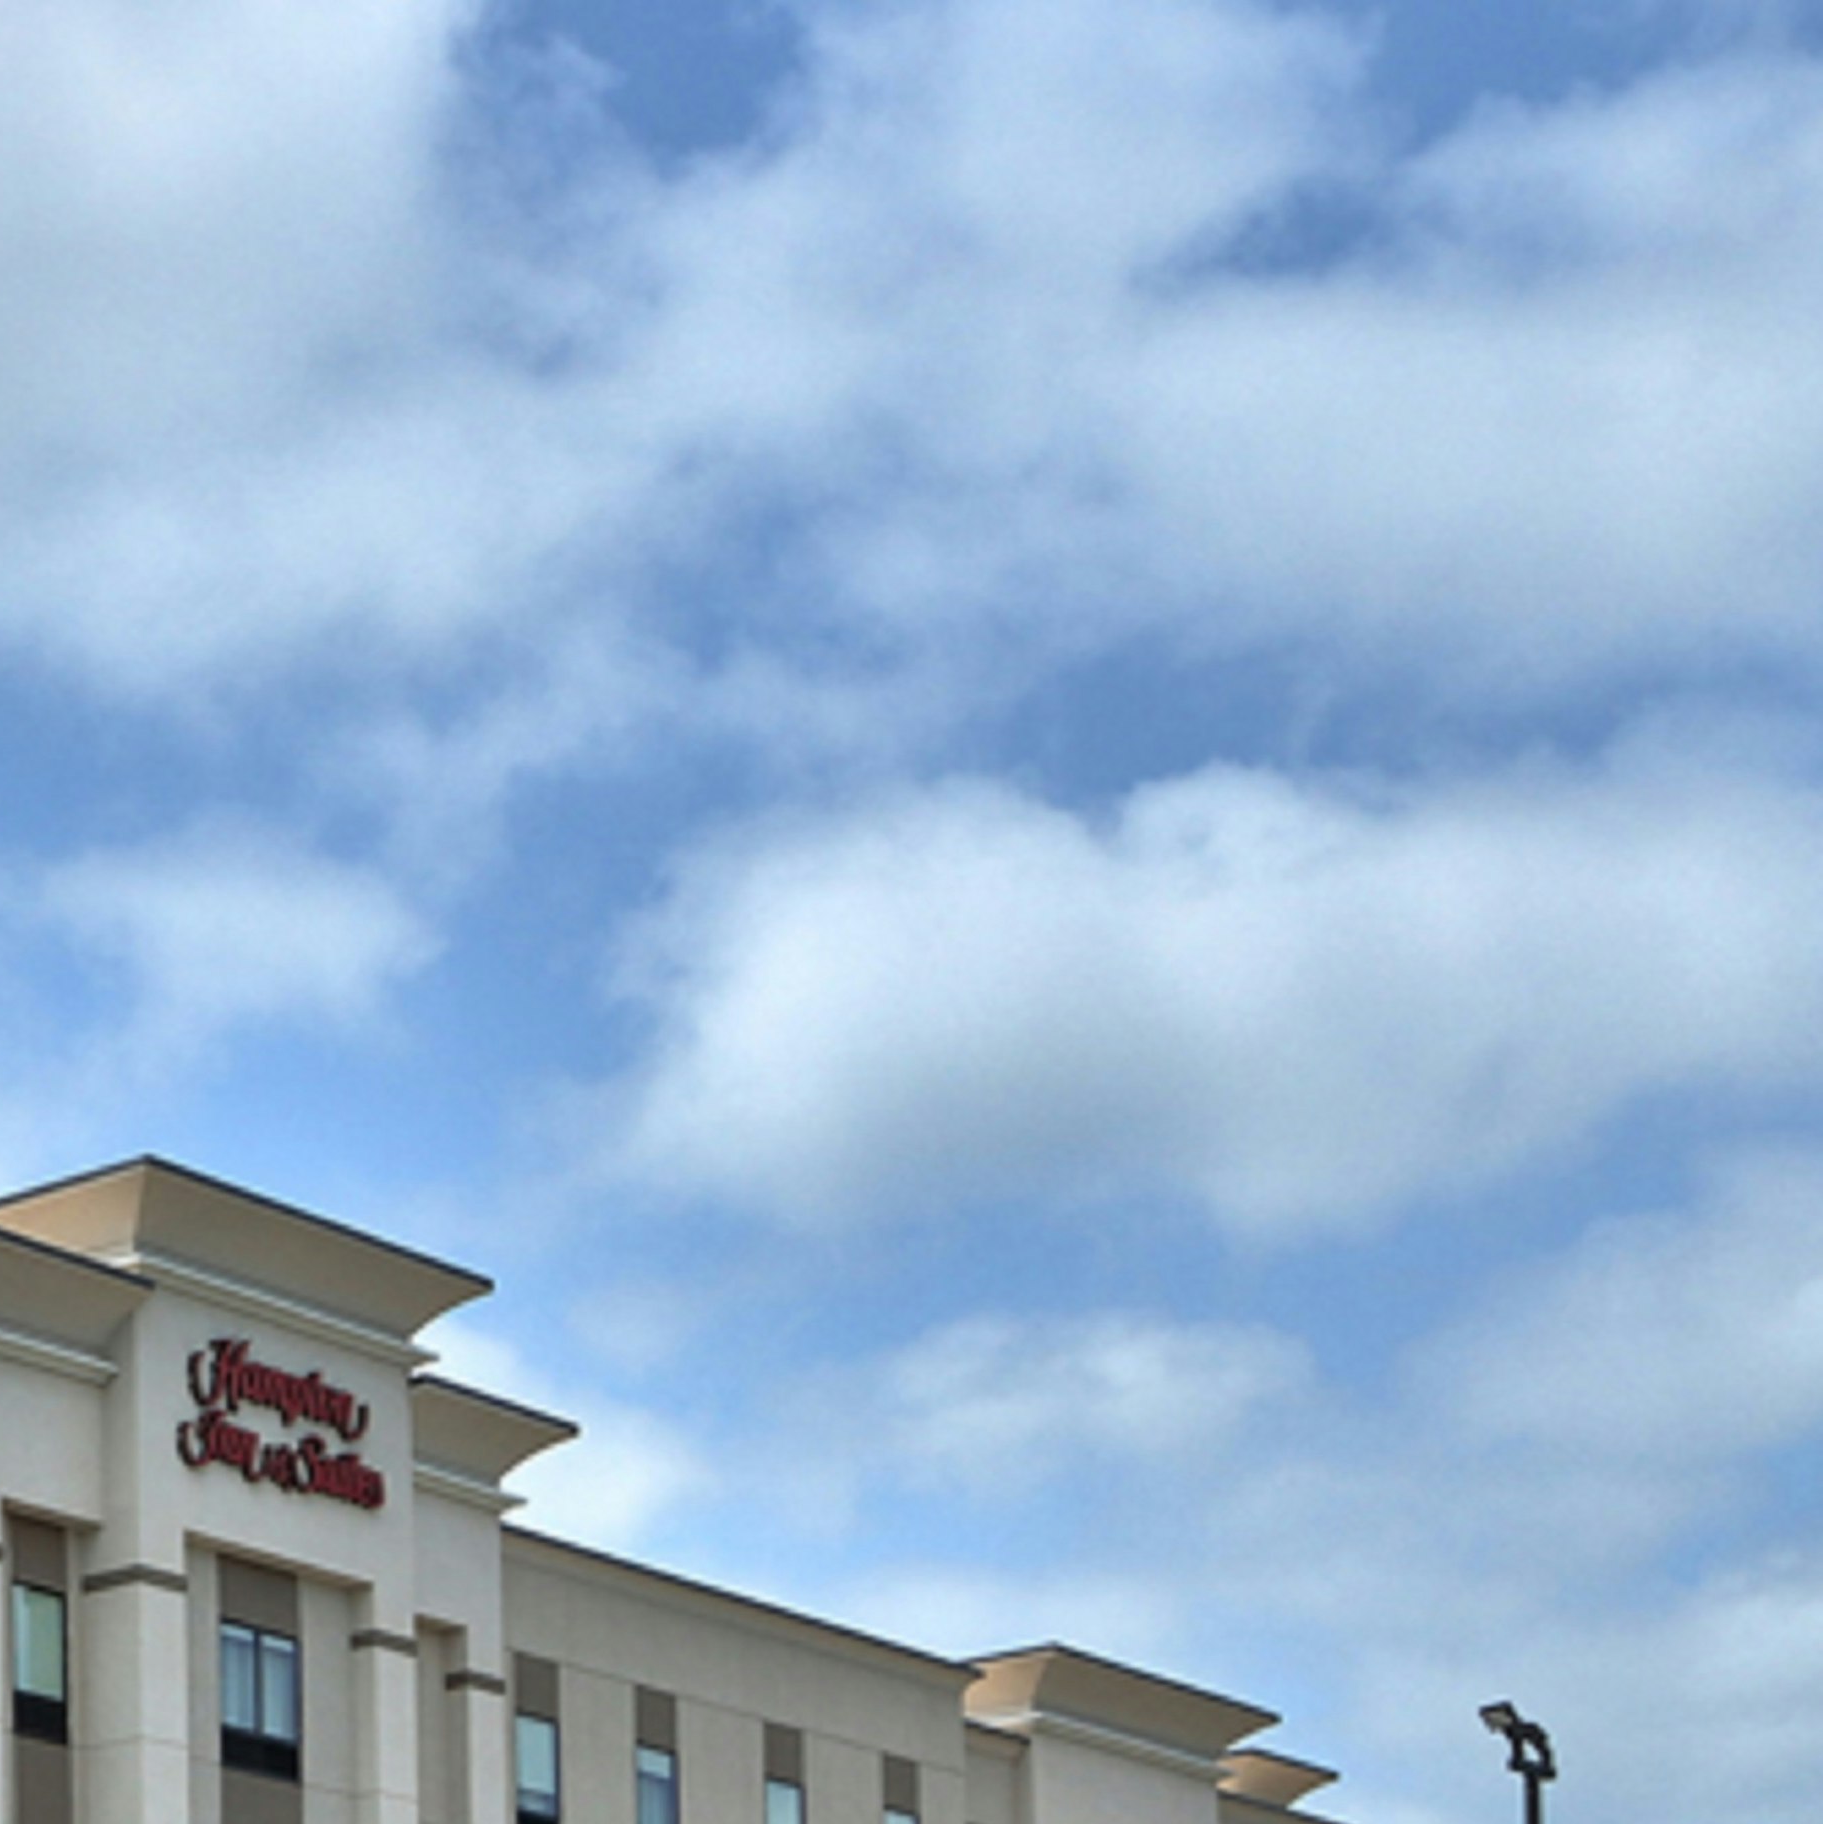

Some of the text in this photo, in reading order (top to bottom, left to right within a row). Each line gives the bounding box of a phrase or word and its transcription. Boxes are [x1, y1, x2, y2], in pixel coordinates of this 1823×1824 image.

[187, 1338, 369, 1443] Hampton
[177, 1410, 263, 1482] Inn
[293, 1433, 386, 1510] Suites
